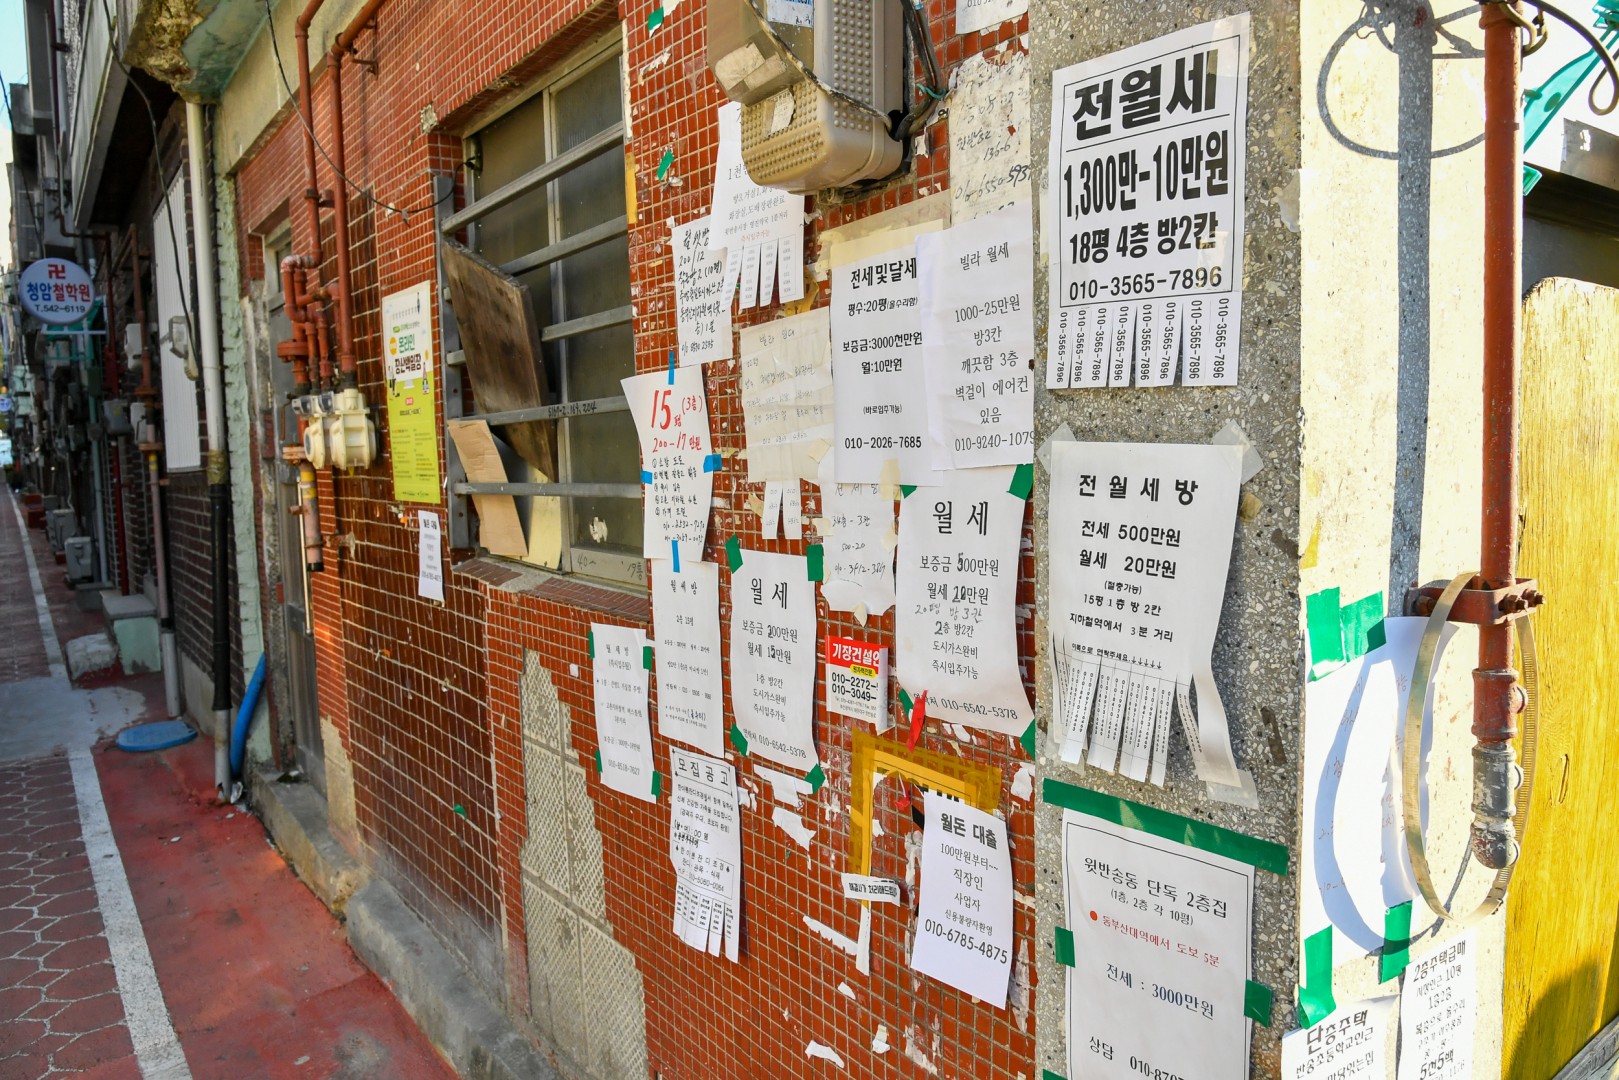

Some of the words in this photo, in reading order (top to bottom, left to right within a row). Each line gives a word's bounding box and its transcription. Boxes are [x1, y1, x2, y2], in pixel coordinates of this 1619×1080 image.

[1073, 49, 1218, 141] 전월세
[1064, 130, 1228, 220] 1,300만-10만원
[1070, 229, 1109, 264] 18평
[1116, 222, 1149, 259] 4층
[1157, 212, 1218, 255] 방2칸
[960, 250, 981, 271] 빌라
[987, 242, 1009, 263] 월세
[850, 257, 917, 290] 전세및달세
[1070, 266, 1222, 300] 010-3565-7896
[956, 294, 1021, 323] 1000-25만원
[843, 332, 923, 353] 보증금:3000천만원
[974, 326, 1002, 347] 방3칸
[1056, 312, 1068, 383] 010-3565-7896
[1075, 309, 1087, 382] 010-3565-7896
[1091, 307, 1107, 381] 010-3565-7896
[1116, 306, 1129, 381] 010-3565-7896
[1140, 304, 1152, 381] 010-3565-7896
[1160, 302, 1176, 379] 010-3565-7896
[1189, 300, 1202, 379] 010-3565-7896
[1211, 298, 1229, 379] 010-3565-7896
[862, 358, 902, 375] 월:10만원
[961, 354, 994, 374] 깨끗함
[1000, 351, 1019, 368] 3층
[955, 382, 986, 402] 벽걸이
[992, 376, 1028, 396] 에어컨
[863, 404, 903, 415] (바로입주가능)
[980, 406, 1002, 425] 있음
[844, 436, 922, 449] 010-2026-7685
[955, 430, 1035, 452] 010-9240-1079
[1082, 520, 1110, 539] 전세
[1118, 524, 1181, 548] 500만원
[920, 555, 952, 573] 보증금
[1080, 549, 1108, 569] 월세
[1124, 556, 1177, 580] 20만원
[927, 582, 948, 601] 월세
[1084, 594, 1104, 607] 15평
[742, 620, 764, 636] 보증금
[954, 623, 974, 638] 방2칸
[1070, 612, 1122, 633] 지하철역에서
[1154, 629, 1174, 642] 거리
[748, 642, 763, 658] 월세
[933, 641, 978, 660] 도시가스완비
[768, 676, 783, 689] 방2칸
[832, 672, 879, 691] 010-2272-
[932, 660, 979, 680] 즉시입주가능
[753, 689, 787, 706] 도시가스완비
[941, 698, 1018, 720] 010-6542-5378
[753, 704, 786, 722] 즉시입주가능
[759, 734, 806, 759] 010-6542-5378
[941, 813, 966, 838] 월돈
[973, 824, 998, 850] 대출
[954, 868, 984, 892] 직장인
[1084, 858, 1139, 890] 윗반송동
[1148, 879, 1178, 902] 단독
[1187, 891, 1227, 919] 2층집
[954, 892, 981, 912] 사업자
[1111, 889, 1129, 905] (1층,
[1133, 898, 1148, 912] 2층
[1154, 904, 1164, 917] 각
[1170, 910, 1194, 926] 10평)
[945, 909, 993, 936] 신용불량자환영
[925, 918, 1008, 964] 010-6785-4875
[1102, 915, 1170, 951] 동부산대역에서
[1177, 943, 1199, 959] 도보
[1204, 953, 1220, 968] 5분
[1413, 940, 1466, 983] 2층주택급매
[1106, 964, 1132, 989] 전세
[1152, 984, 1214, 1021] 3000만원
[1307, 1010, 1368, 1055] 단층주택
[1089, 1036, 1114, 1061] 상담
[1296, 1027, 1374, 1080] 반송초등학교인근
[1420, 1049, 1454, 1080] 5천5백
